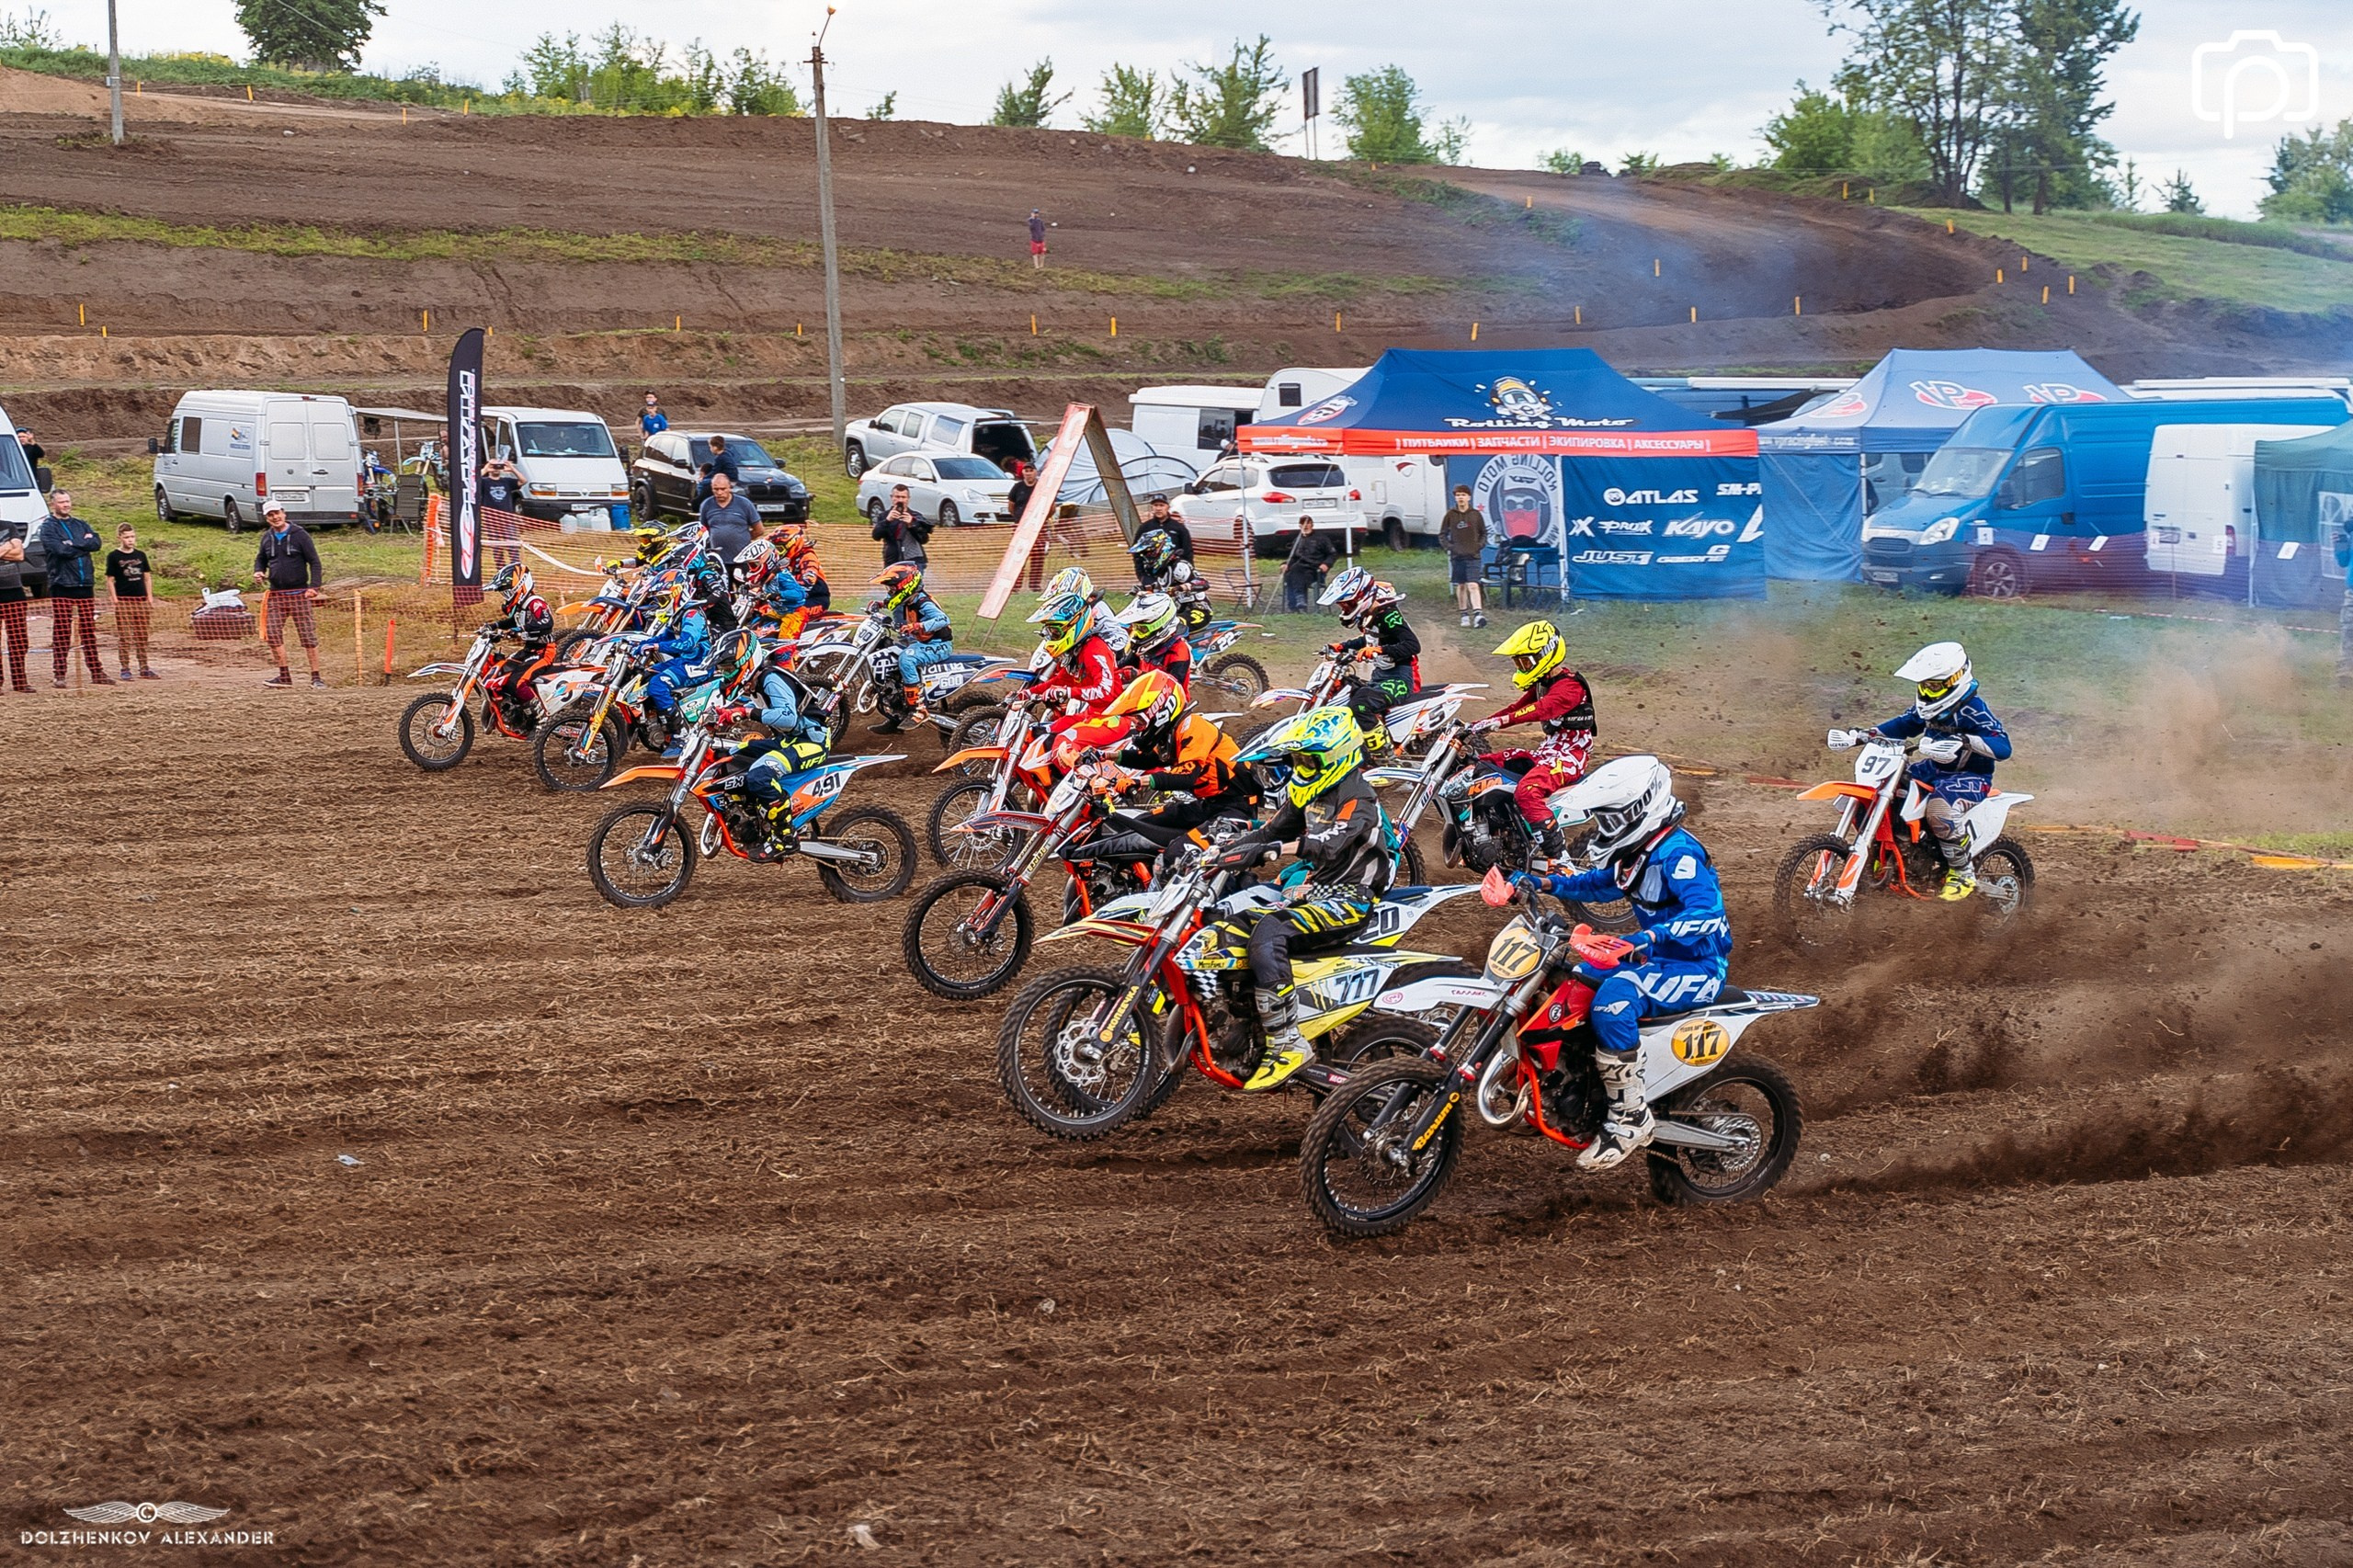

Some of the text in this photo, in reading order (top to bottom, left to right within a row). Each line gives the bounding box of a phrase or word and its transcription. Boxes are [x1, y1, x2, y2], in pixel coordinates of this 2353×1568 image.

[1444, 417, 1634, 430] Rolling Moto
[1477, 437, 1540, 448] ЗАПЧАСТИ
[1549, 437, 1625, 449] ЭКИПИРОВКА
[1633, 438, 1705, 449] АКСЕССУАРЫ
[1625, 489, 1699, 505] ATLAS
[1661, 511, 1735, 540] KAYO
[1861, 756, 1892, 776] 97
[724, 776, 745, 790] SX
[812, 773, 841, 798] 491
[1467, 777, 1504, 796] KTM
[1622, 780, 1662, 823] 100%
[1490, 936, 1538, 972] 117
[1336, 969, 1380, 1004] 777
[1682, 1029, 1722, 1059] 117
[1411, 1102, 1453, 1150] Barum
